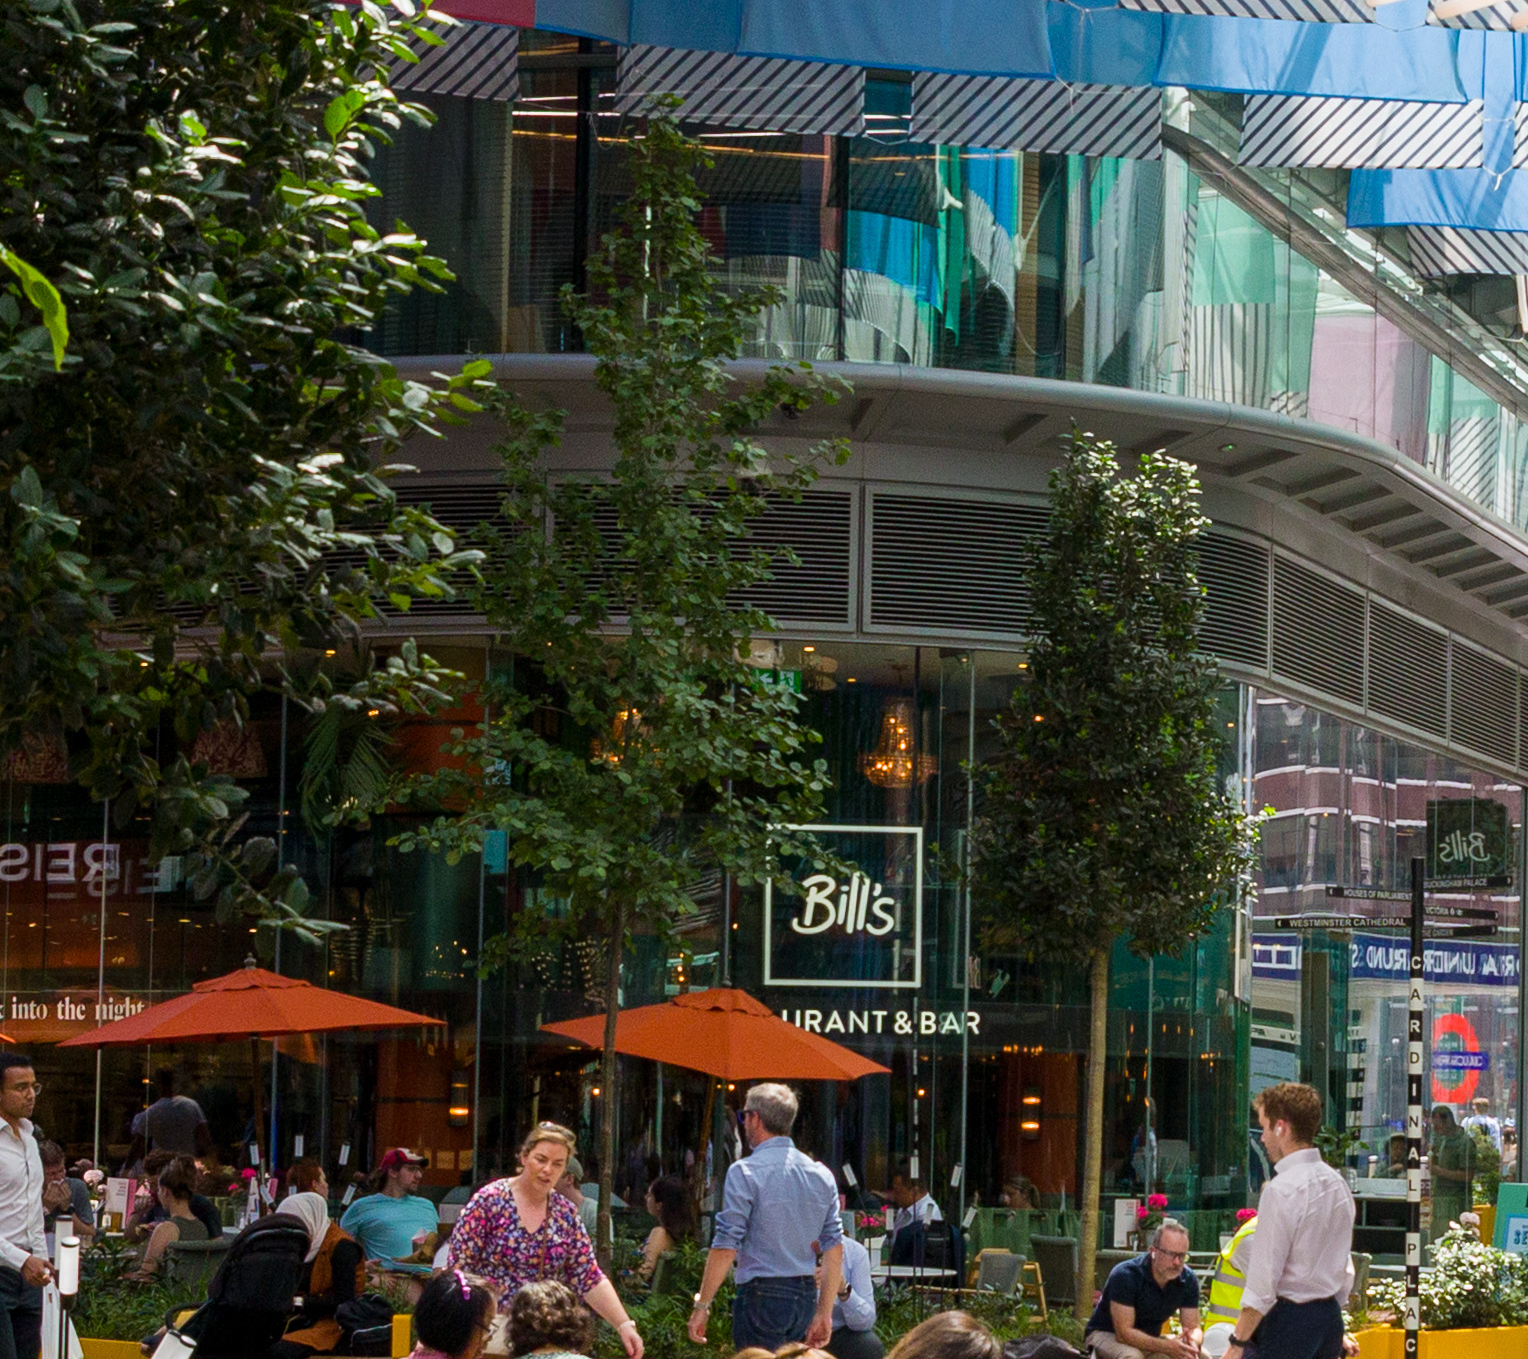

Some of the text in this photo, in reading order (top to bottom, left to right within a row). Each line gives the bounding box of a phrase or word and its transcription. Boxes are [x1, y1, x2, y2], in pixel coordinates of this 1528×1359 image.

[1344, 888, 1369, 897] HOUSES
[1372, 889, 1380, 898] OF
[1462, 877, 1488, 887] PALACE
[792, 871, 895, 936] Bill's
[1290, 918, 1406, 928] WESTMINSTER CATHEDRAL
[12, 996, 48, 1020] into
[57, 997, 86, 1020] the
[894, 1010, 913, 1035] &
[921, 1011, 981, 1035] BAR
[1408, 955, 1422, 1193] CARDINAL
